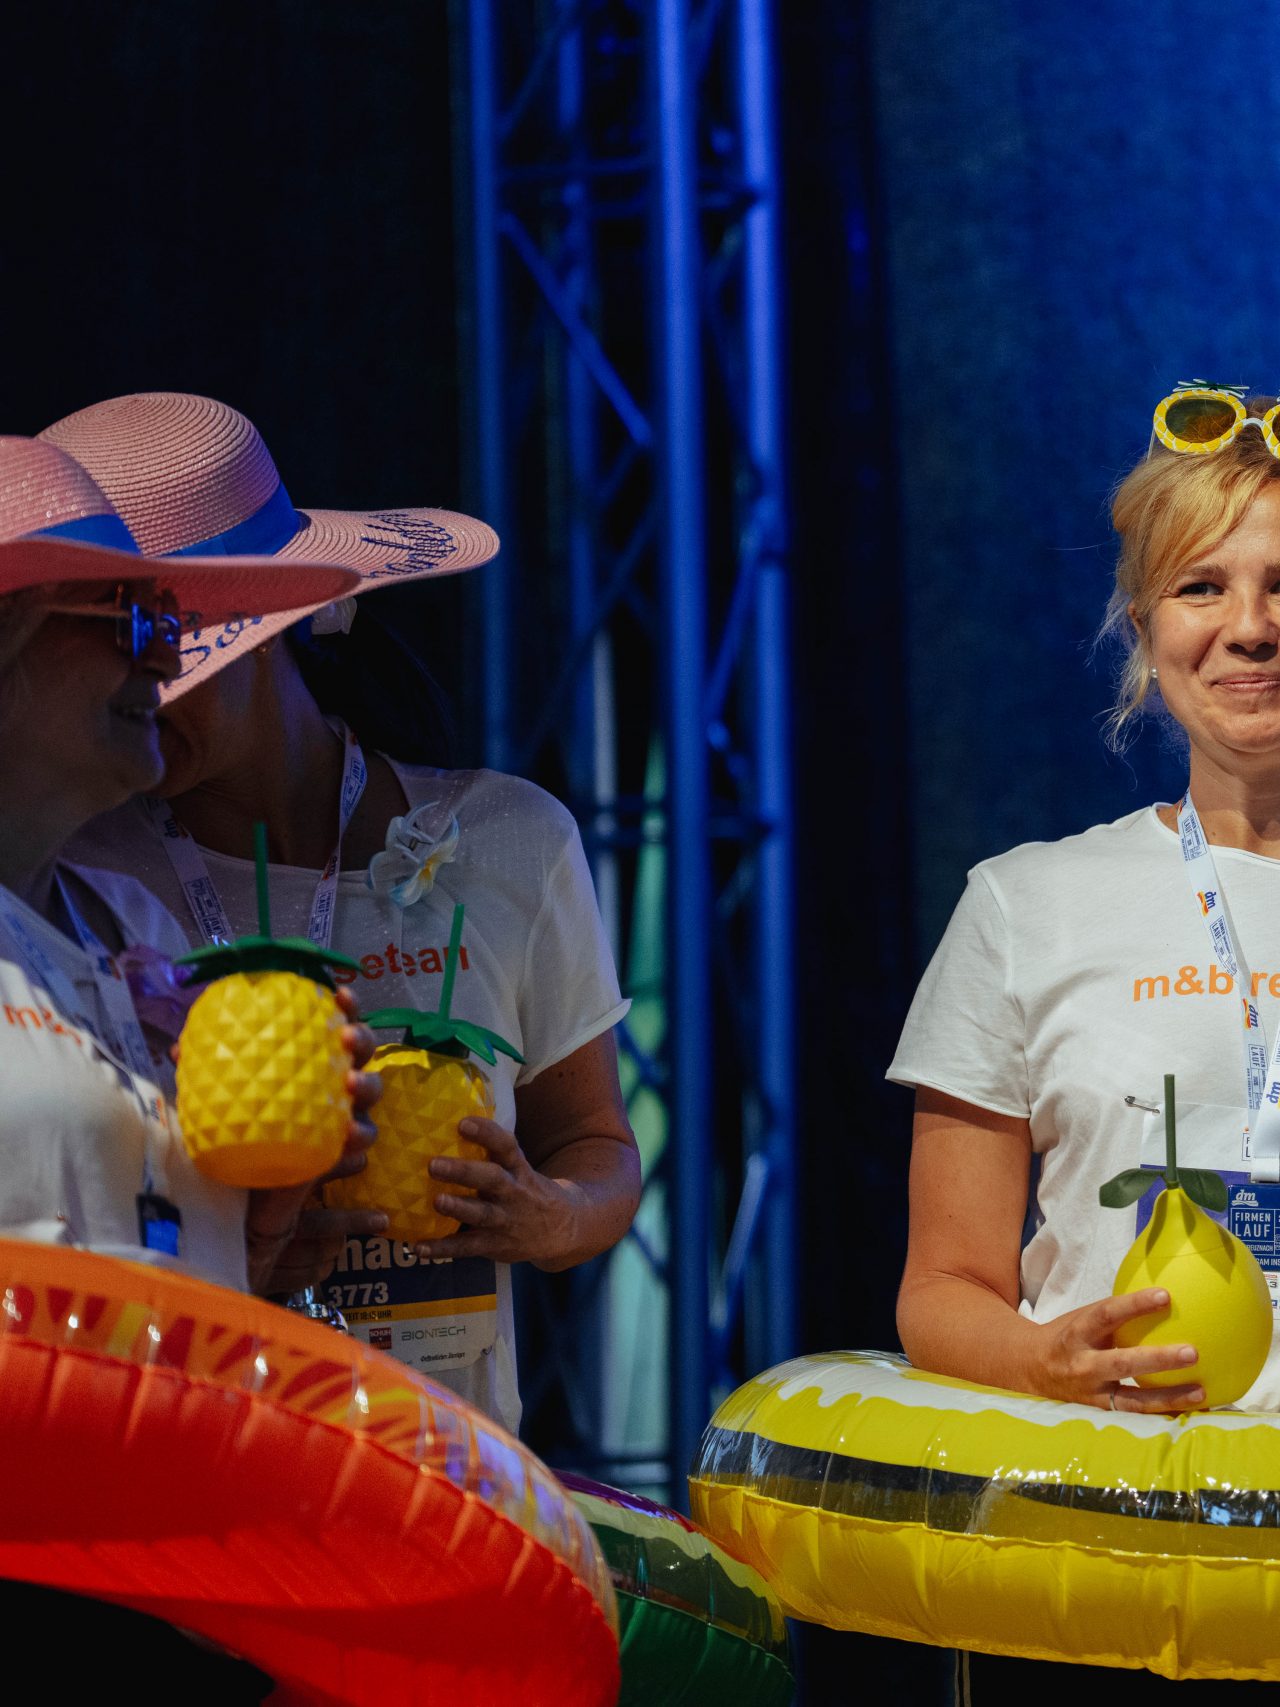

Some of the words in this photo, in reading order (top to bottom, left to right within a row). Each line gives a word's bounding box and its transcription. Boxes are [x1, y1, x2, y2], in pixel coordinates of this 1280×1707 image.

[1204, 891, 1217, 910] dm
[1133, 964, 1234, 1002] m&b
[1248, 1004, 1259, 1028] dm
[1235, 1189, 1256, 1201] dm
[1235, 1212, 1271, 1223] FIRMEN
[1235, 1223, 1271, 1238] LAUF
[328, 1281, 389, 1308] 3773
[401, 1326, 466, 1341] BIONTECH
